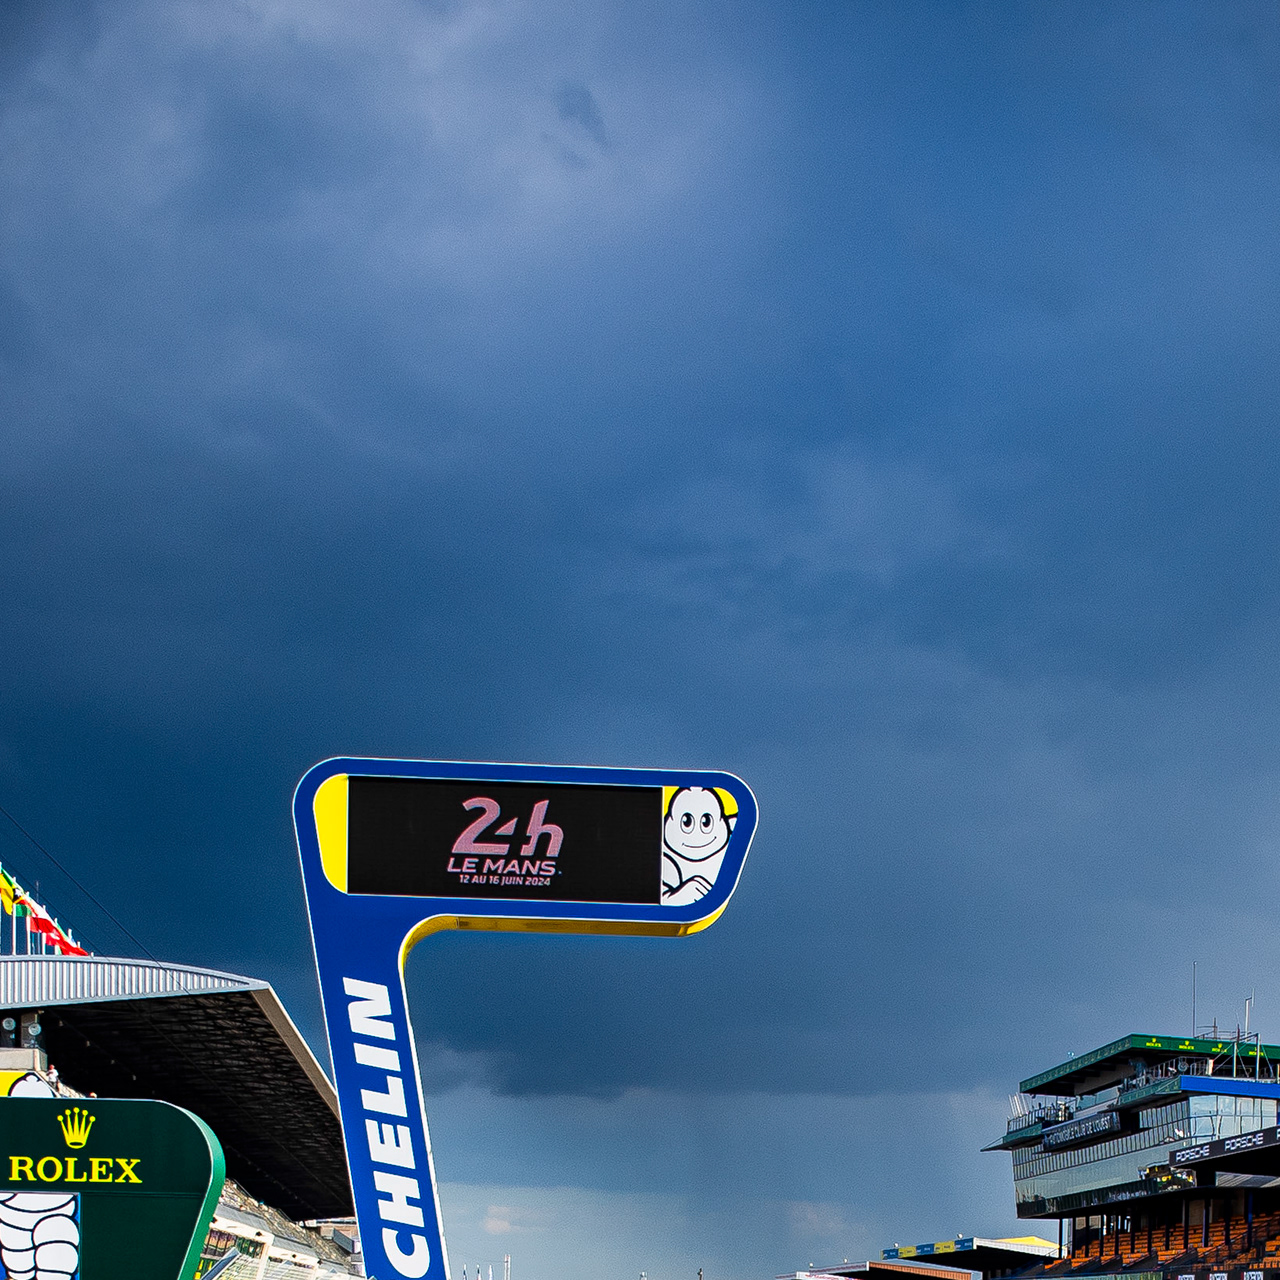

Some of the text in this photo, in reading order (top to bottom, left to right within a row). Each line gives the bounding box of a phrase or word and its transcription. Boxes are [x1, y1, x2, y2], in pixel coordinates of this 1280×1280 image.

[451, 797, 564, 857] 24h
[447, 857, 557, 877] LE MANS
[459, 874, 551, 887] 12 AU 16 JUIN 2024
[341, 976, 432, 1279] CHELIN
[1224, 1132, 1264, 1151] PORSCHE
[1176, 1145, 1210, 1162] PORSCHE
[8, 1155, 143, 1184] ROLEX
